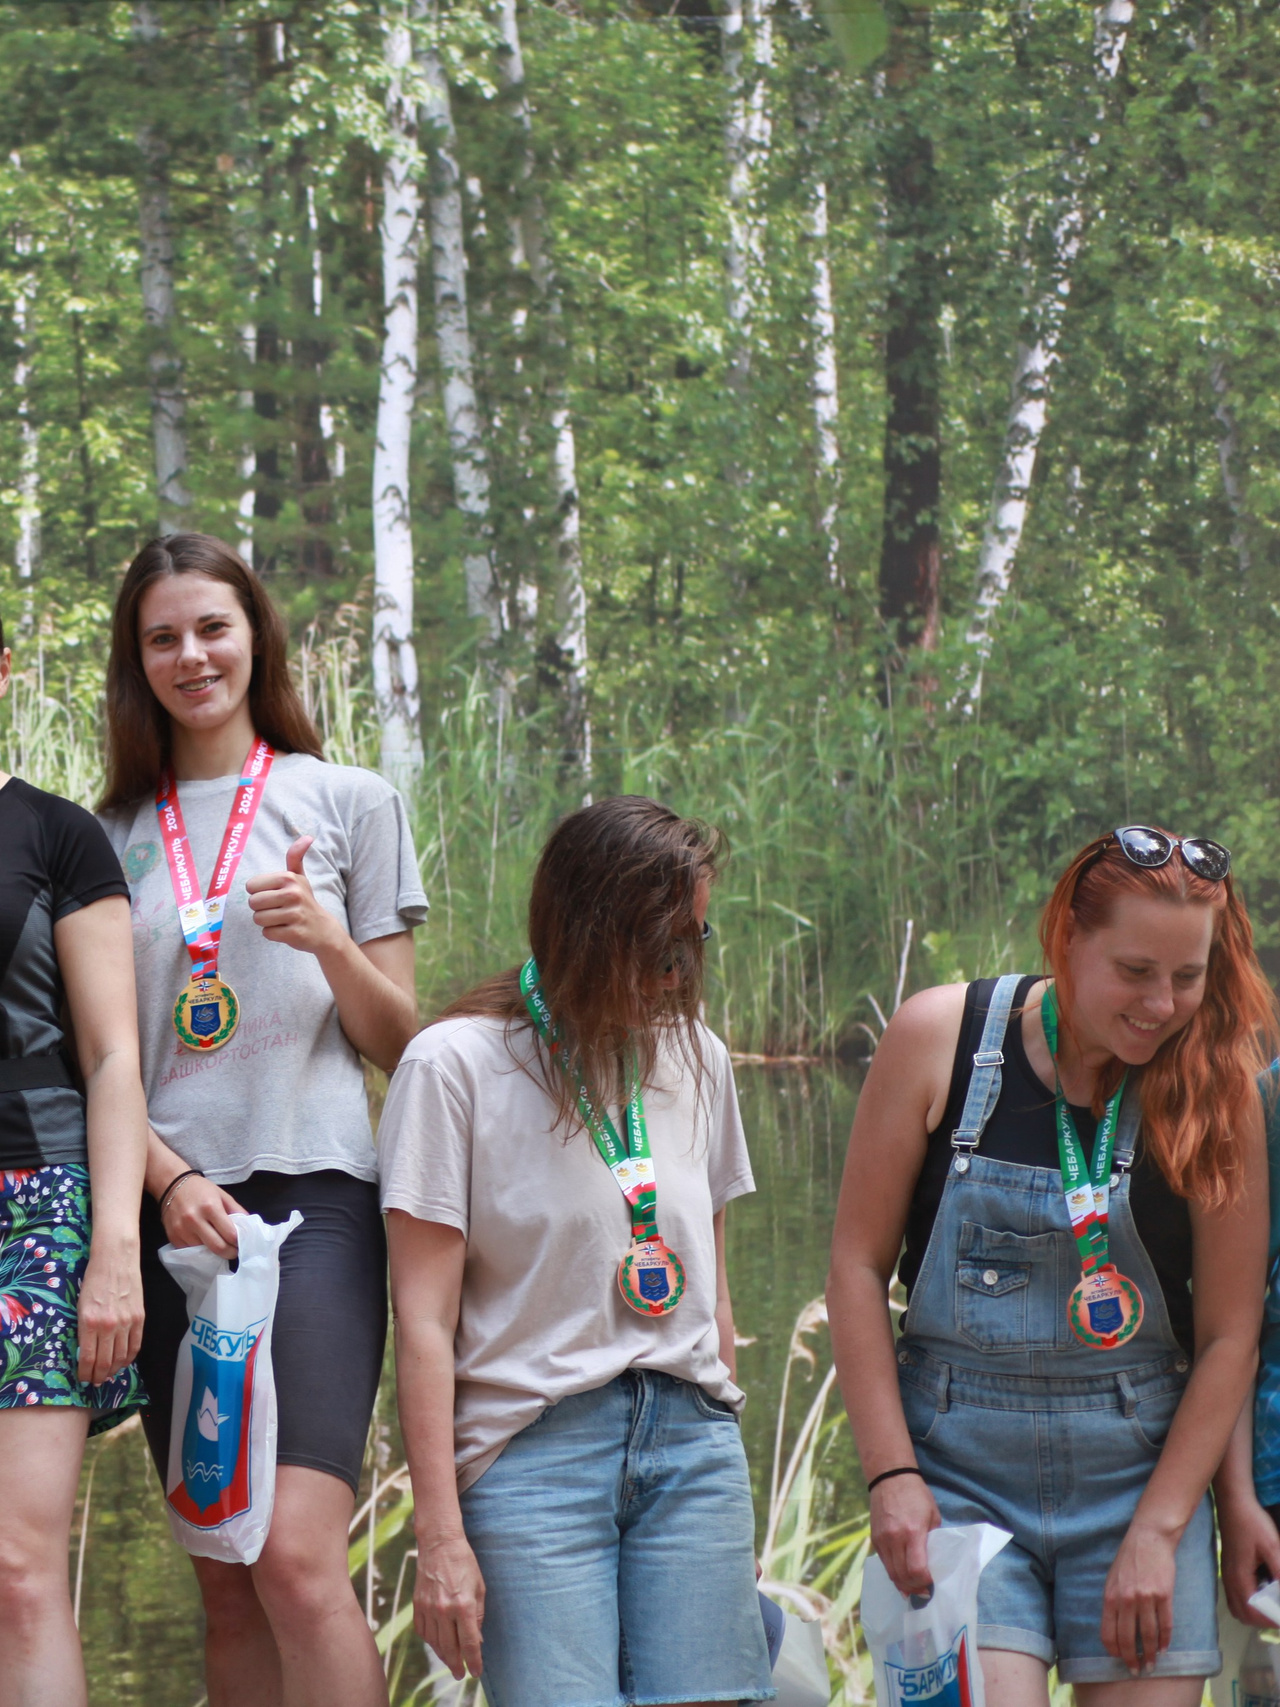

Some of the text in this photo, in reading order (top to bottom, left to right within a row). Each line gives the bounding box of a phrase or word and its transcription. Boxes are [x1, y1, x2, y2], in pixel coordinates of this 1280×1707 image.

[164, 805, 178, 832] 2024
[214, 786, 256, 890] ЧЕБАРКУЛЬ 2024
[171, 837, 193, 903] ЧЕБАРКУЛЬ
[1059, 1103, 1080, 1182] ЧЕБАРКУЛЬ
[1095, 1098, 1116, 1180] ЧЕБАРКУЛЬ
